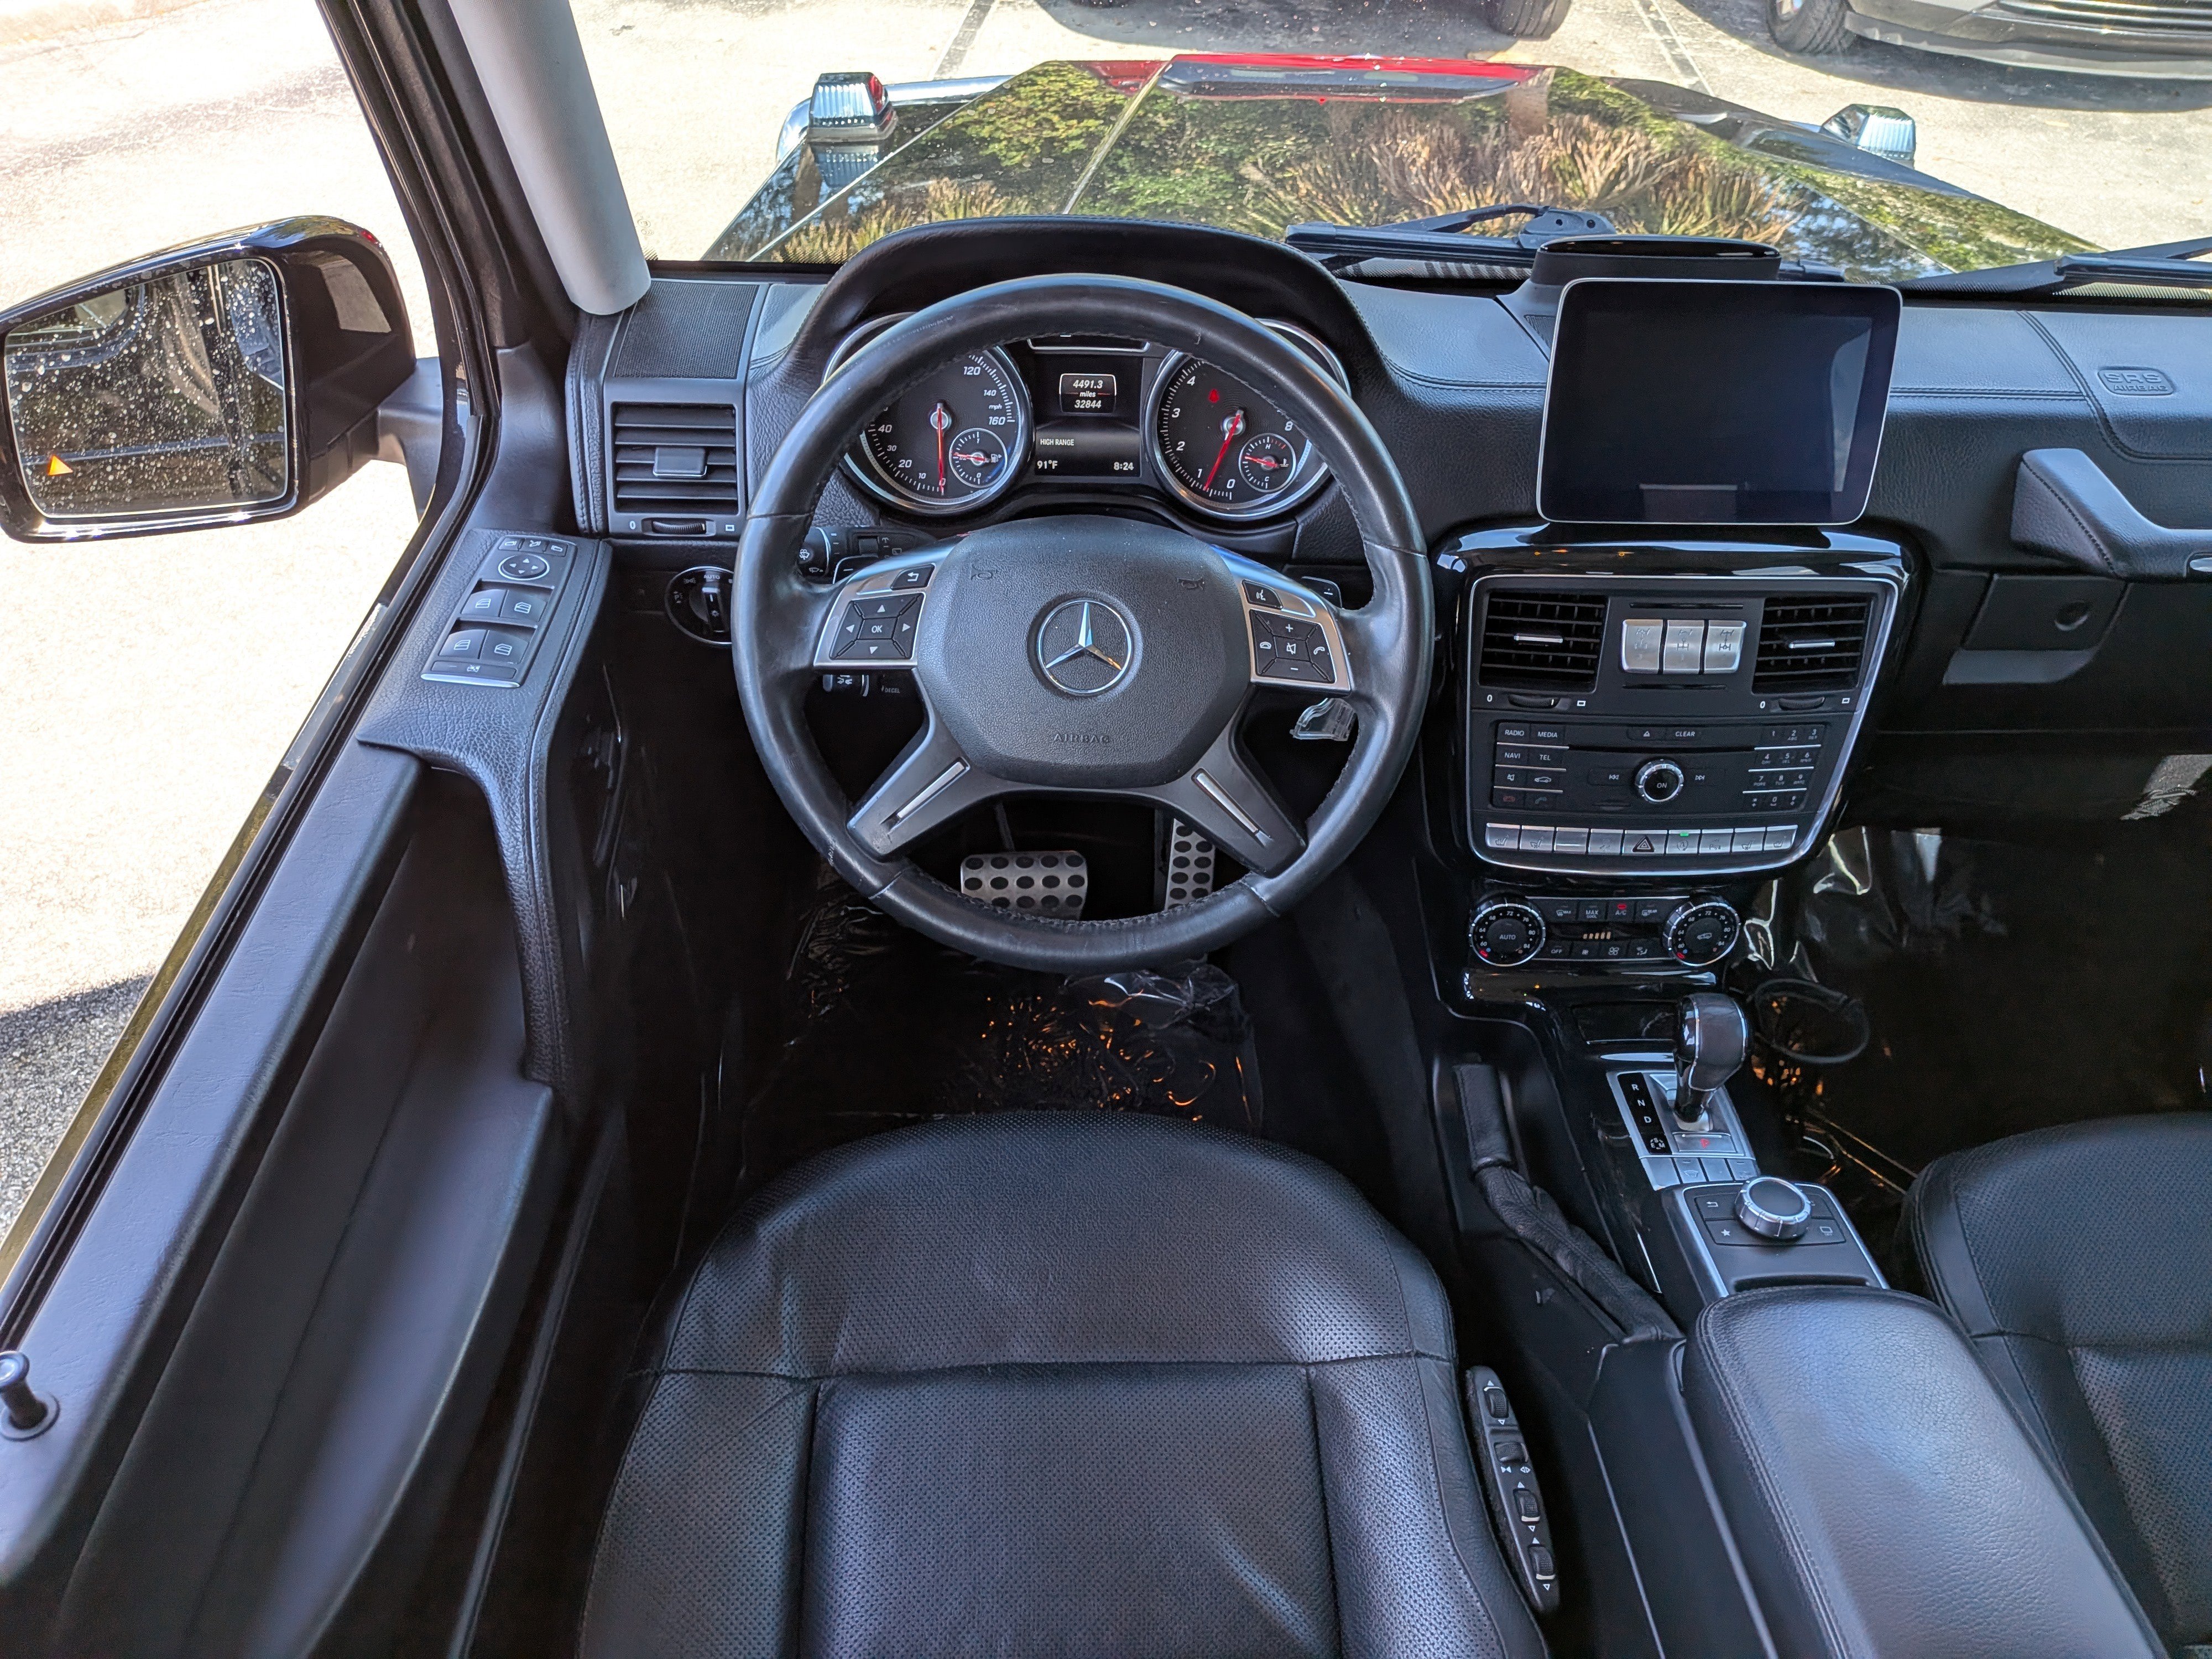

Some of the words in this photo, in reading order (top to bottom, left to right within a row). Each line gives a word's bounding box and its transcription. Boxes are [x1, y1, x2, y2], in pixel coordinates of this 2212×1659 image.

[963, 366, 980, 375] 120
[1187, 375, 1196, 386] 4
[2104, 372, 2162, 383] SRS
[1073, 379, 1103, 389] 4491.3
[1074, 399, 1102, 409] 32844
[1171, 408, 1181, 418] 3
[988, 416, 1005, 425] 160
[878, 424, 892, 433] 40
[1285, 421, 1293, 431] 8
[1176, 441, 1185, 451] 2
[898, 459, 912, 468] 20
[1037, 460, 1058, 469] 91°F
[1113, 462, 1134, 471] 8:24
[1197, 468, 1203, 478] 1
[1227, 479, 1235, 488] 0
[871, 625, 883, 633] OK
